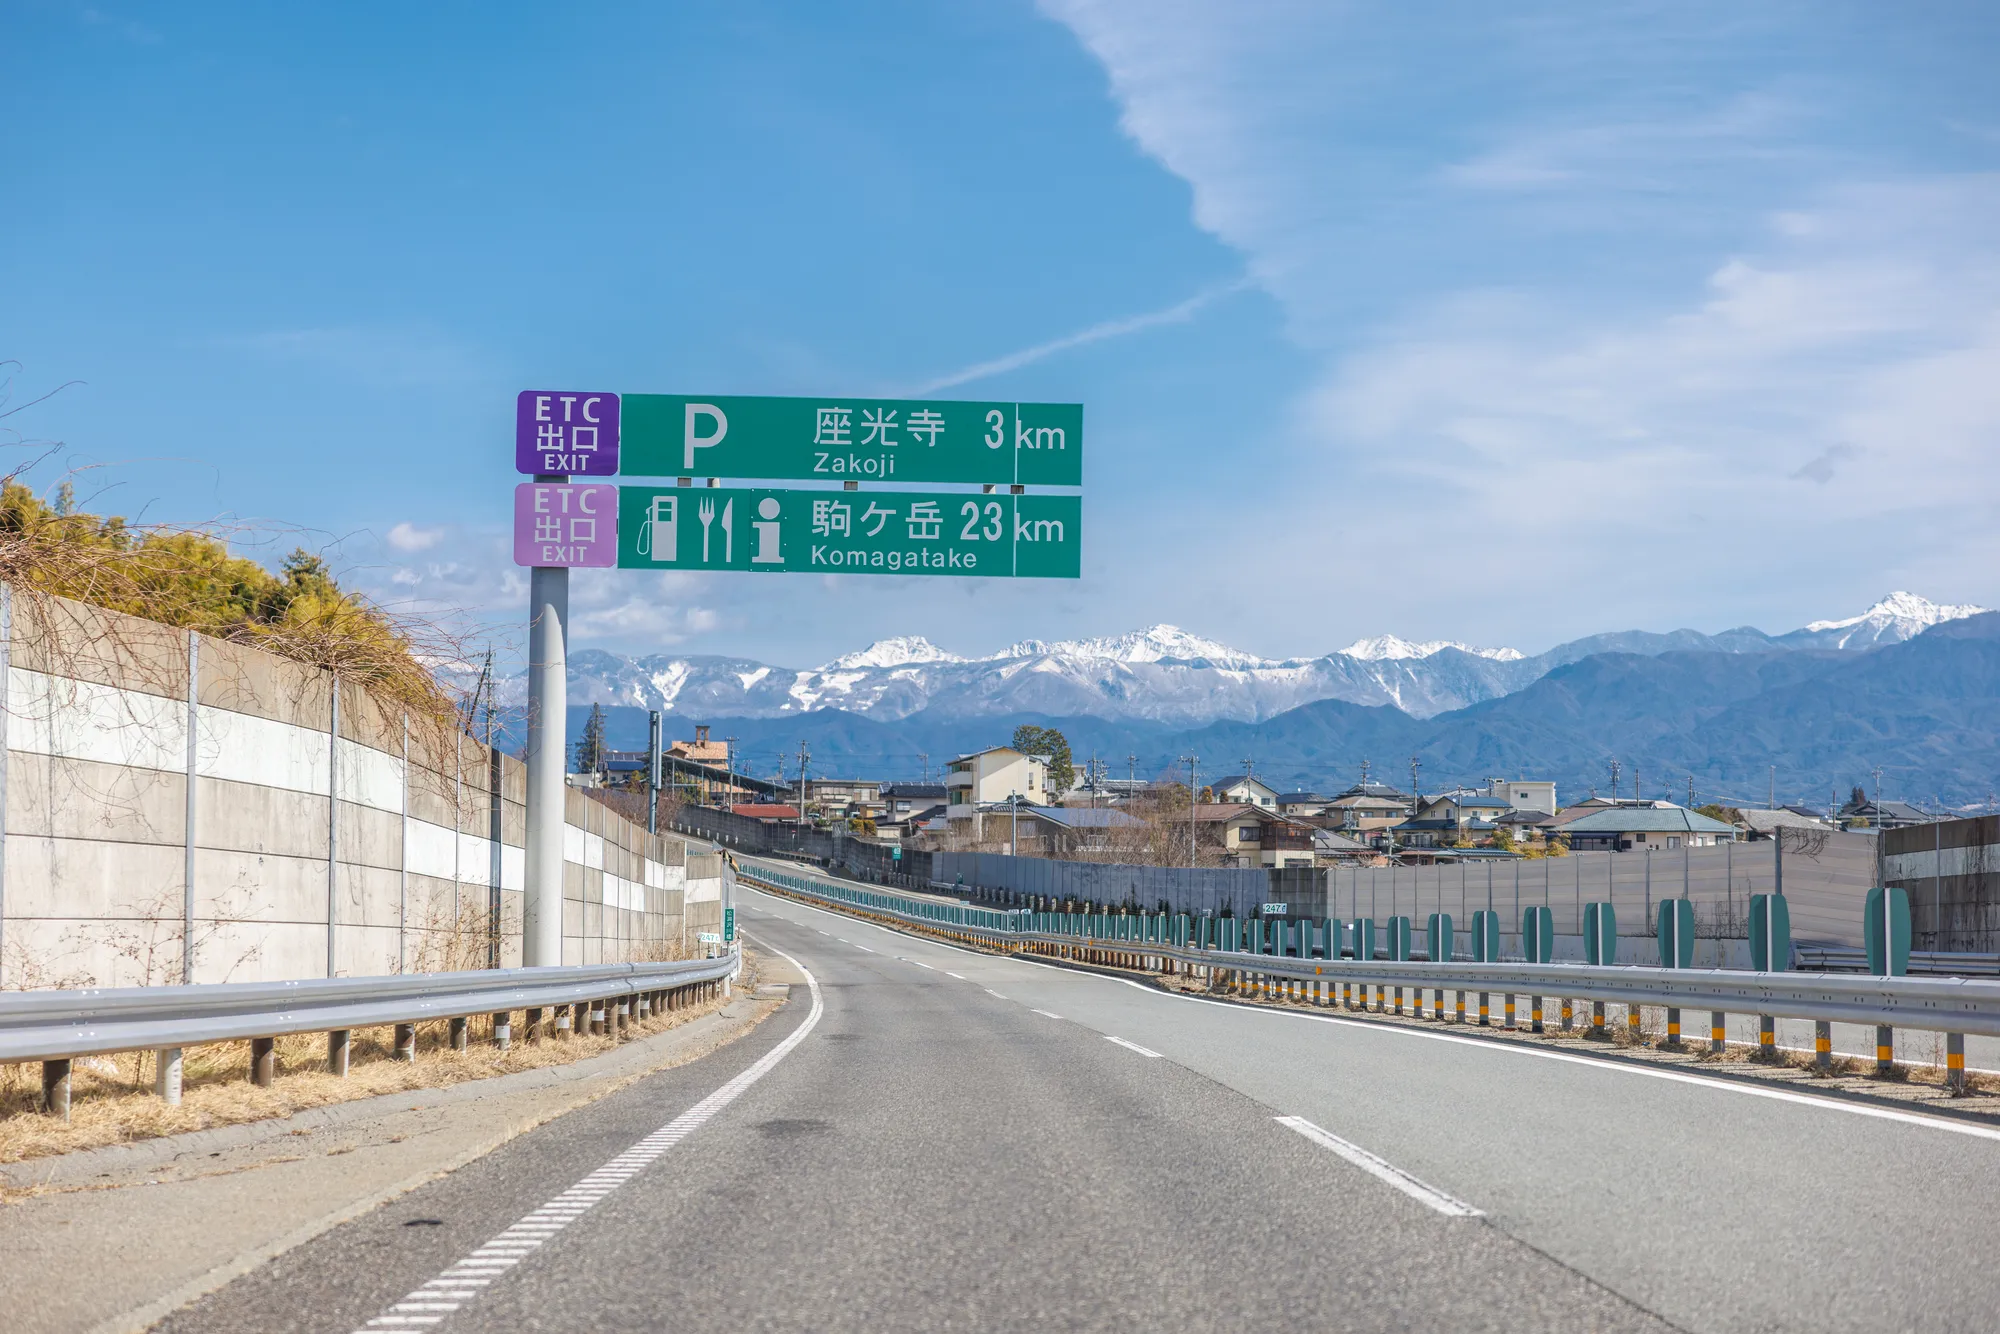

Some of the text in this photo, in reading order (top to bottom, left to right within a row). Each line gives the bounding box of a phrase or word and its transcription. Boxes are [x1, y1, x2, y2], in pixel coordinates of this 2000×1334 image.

[536, 396, 600, 422] ETC
[537, 424, 598, 451] 出口
[684, 403, 728, 469] P
[813, 407, 1065, 449] 座光寺 3 km
[544, 454, 589, 471] EXIT
[813, 453, 895, 478] Zakoji
[534, 488, 597, 514] ETC
[534, 516, 596, 543] 出口
[960, 502, 1003, 541] 23
[1015, 513, 1064, 542] km
[542, 546, 587, 562] EXIT
[811, 545, 977, 570] Komagatake
